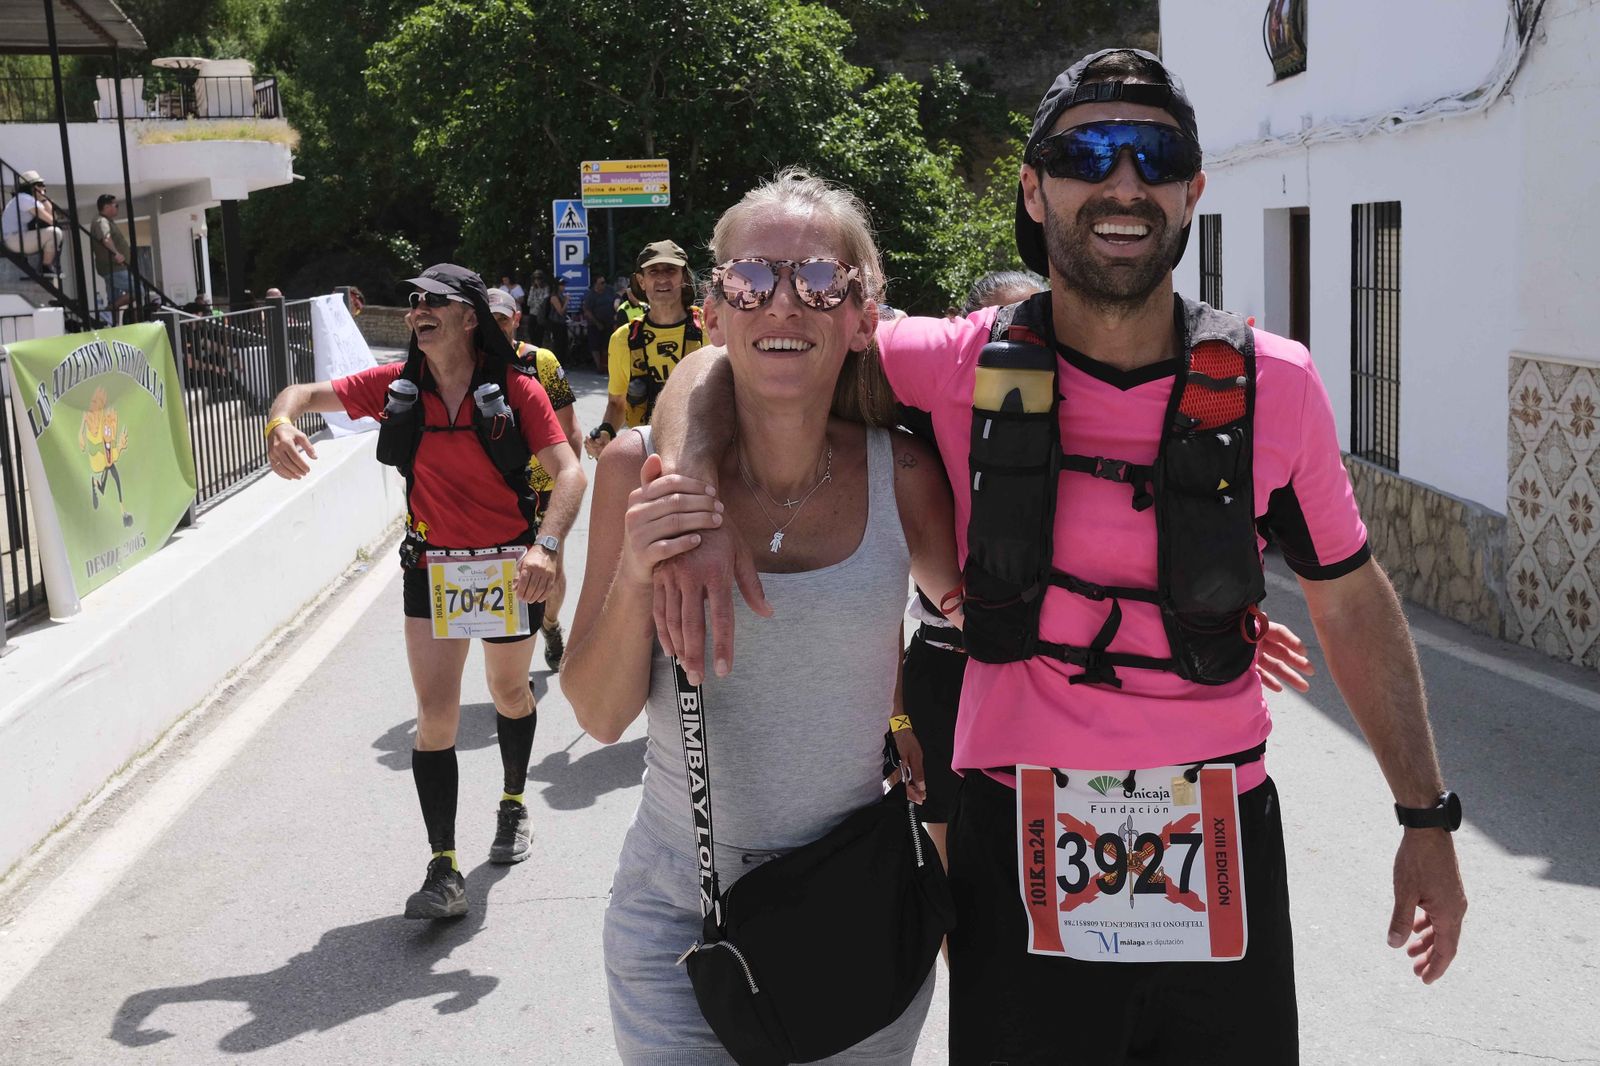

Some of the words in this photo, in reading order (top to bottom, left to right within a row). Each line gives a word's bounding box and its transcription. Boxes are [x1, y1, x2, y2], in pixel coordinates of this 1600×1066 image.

[565, 245, 578, 261] P
[53, 341, 112, 402] ATLETISMO
[445, 587, 504, 613] 7072
[1123, 786, 1170, 801] Unicaja
[1090, 804, 1169, 814] Fundación
[1213, 818, 1226, 848] XXIII
[1057, 832, 1203, 895] 3927
[1215, 852, 1232, 906] EDICIÓN
[1099, 920, 1149, 928] EMERGENCIA
[1152, 920, 1162, 928] DE
[1163, 920, 1204, 929] TELÉFONO
